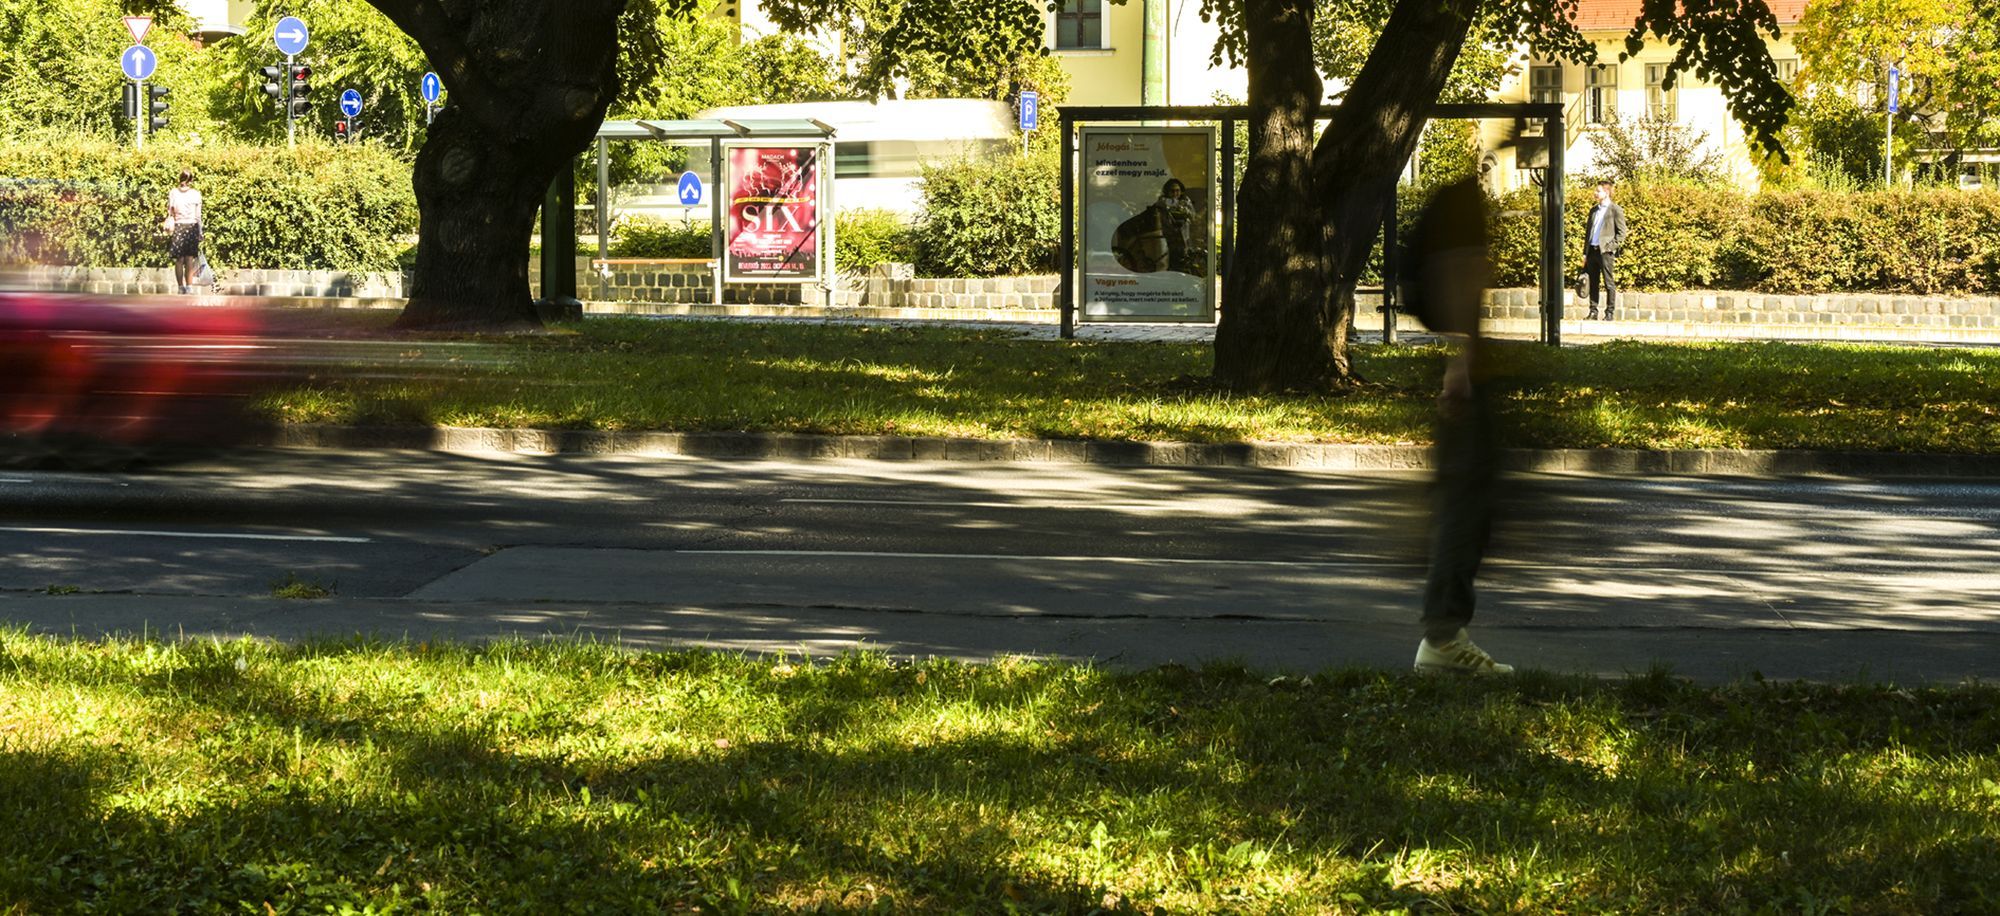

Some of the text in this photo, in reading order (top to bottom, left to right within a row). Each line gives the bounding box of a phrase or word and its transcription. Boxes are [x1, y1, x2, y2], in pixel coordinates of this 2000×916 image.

[1096, 142, 1130, 152] Jófogás
[1095, 159, 1148, 167] Mindenhova
[1143, 168, 1168, 177] majd.
[742, 205, 804, 233] SIX
[1095, 278, 1117, 287] Vagy
